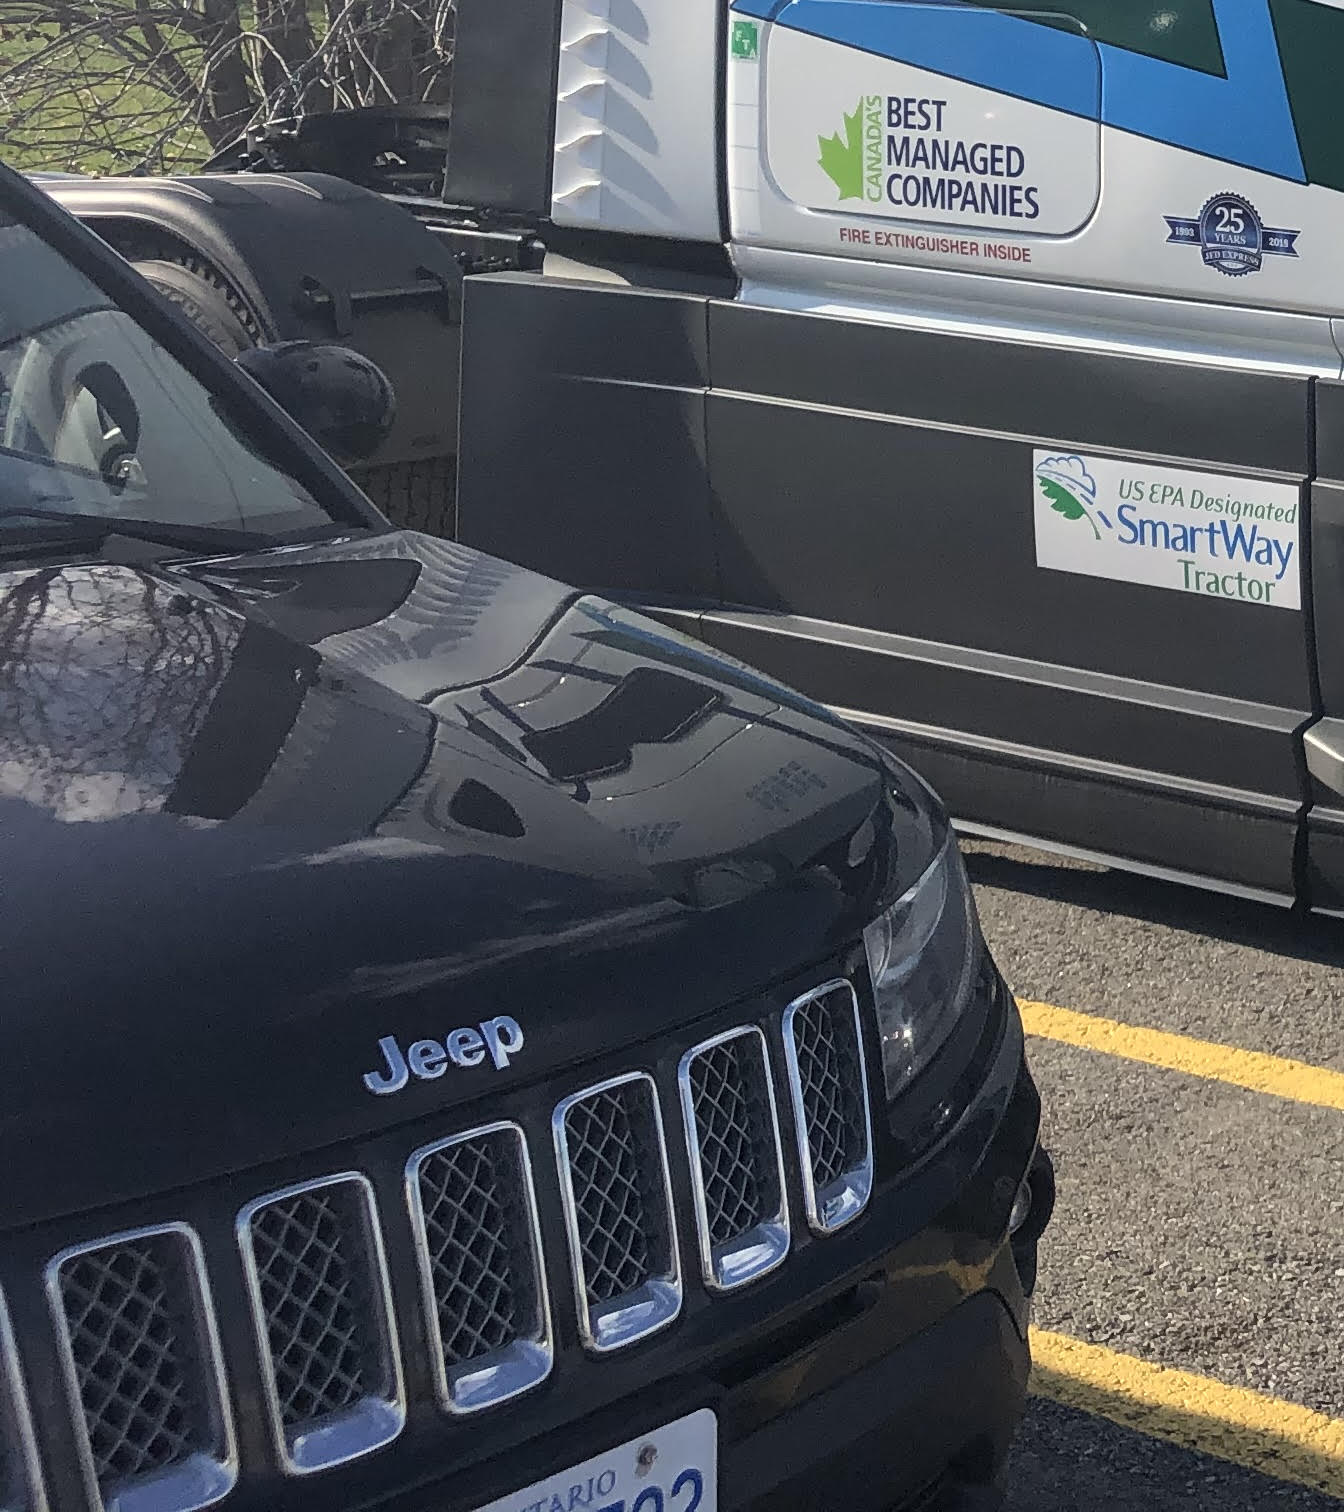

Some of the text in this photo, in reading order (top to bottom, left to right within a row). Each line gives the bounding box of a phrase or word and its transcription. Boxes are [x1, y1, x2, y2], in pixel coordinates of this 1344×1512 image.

[886, 96, 947, 132] BEST
[866, 95, 883, 203] CANADA'S
[886, 135, 1025, 178] MANAGED
[886, 173, 1040, 220] COMPANIES
[1214, 233, 1247, 245] YEARS
[1215, 206, 1245, 234] 25
[839, 227, 1032, 263] FIRE EXTINGUISHER INSIDE
[1119, 479, 1298, 524] US EPA Designated
[1117, 504, 1294, 580] SmartWay
[1177, 559, 1276, 603] Tractor
[363, 1015, 524, 1095] Jeep
